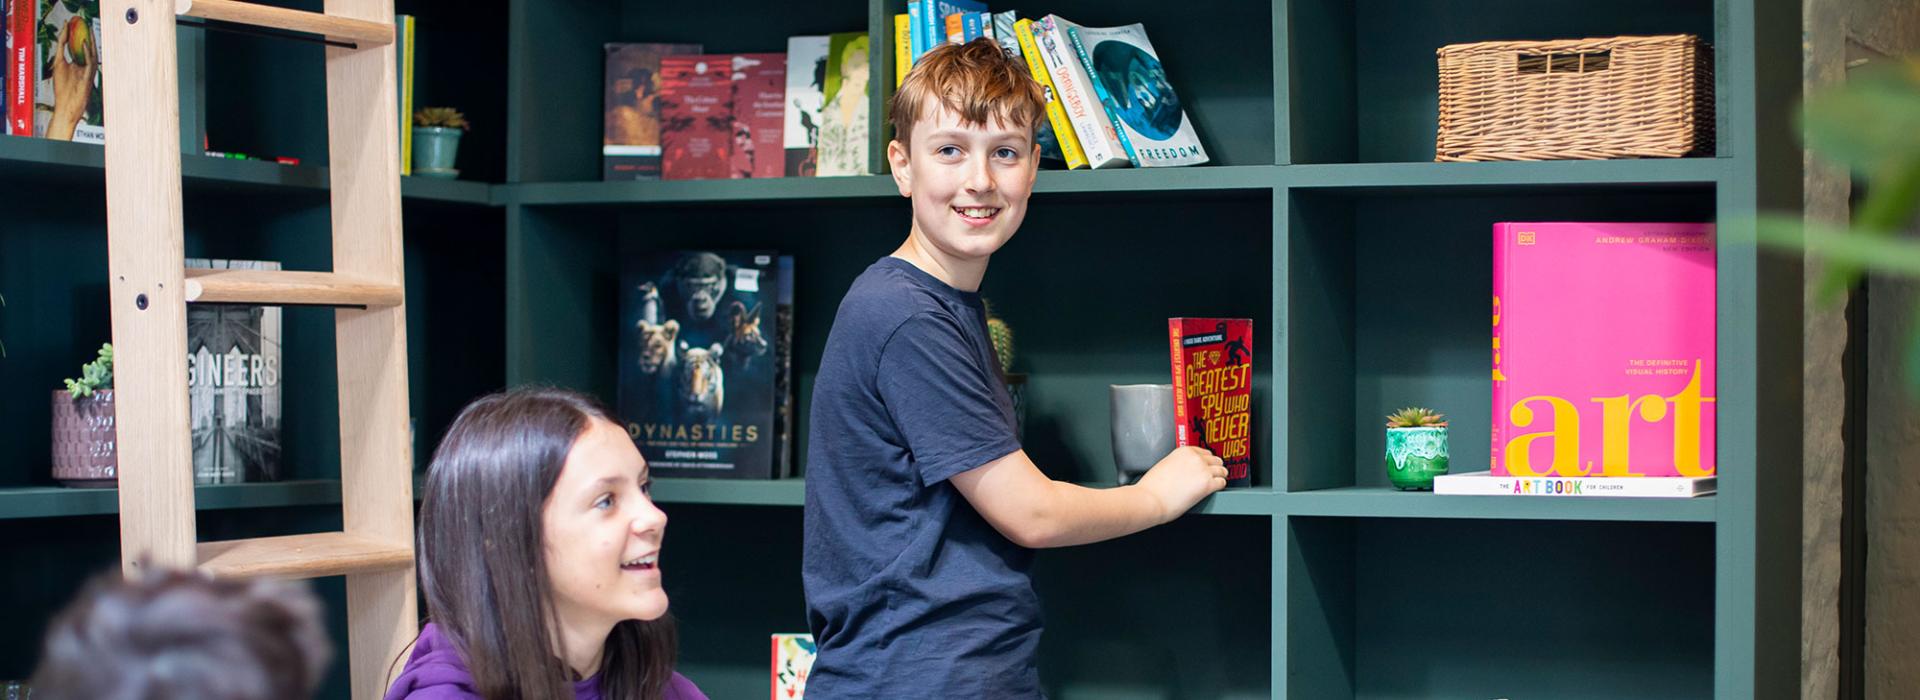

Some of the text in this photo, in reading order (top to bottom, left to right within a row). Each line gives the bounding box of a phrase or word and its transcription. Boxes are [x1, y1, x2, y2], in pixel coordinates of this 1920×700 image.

[1055, 66, 1087, 119] ORANGEBOY
[1139, 145, 1199, 160] FREEDOM
[1193, 350, 1207, 370] THE
[1186, 364, 1249, 399] GREATEST
[1201, 391, 1249, 420] SPY WHO
[1505, 358, 1716, 477] art
[629, 424, 758, 441] DYNASTIES
[1206, 413, 1249, 444] NEVER
[1223, 438, 1248, 459] WAS
[1514, 480, 1541, 494] ART
[1545, 480, 1582, 495] BOOK
